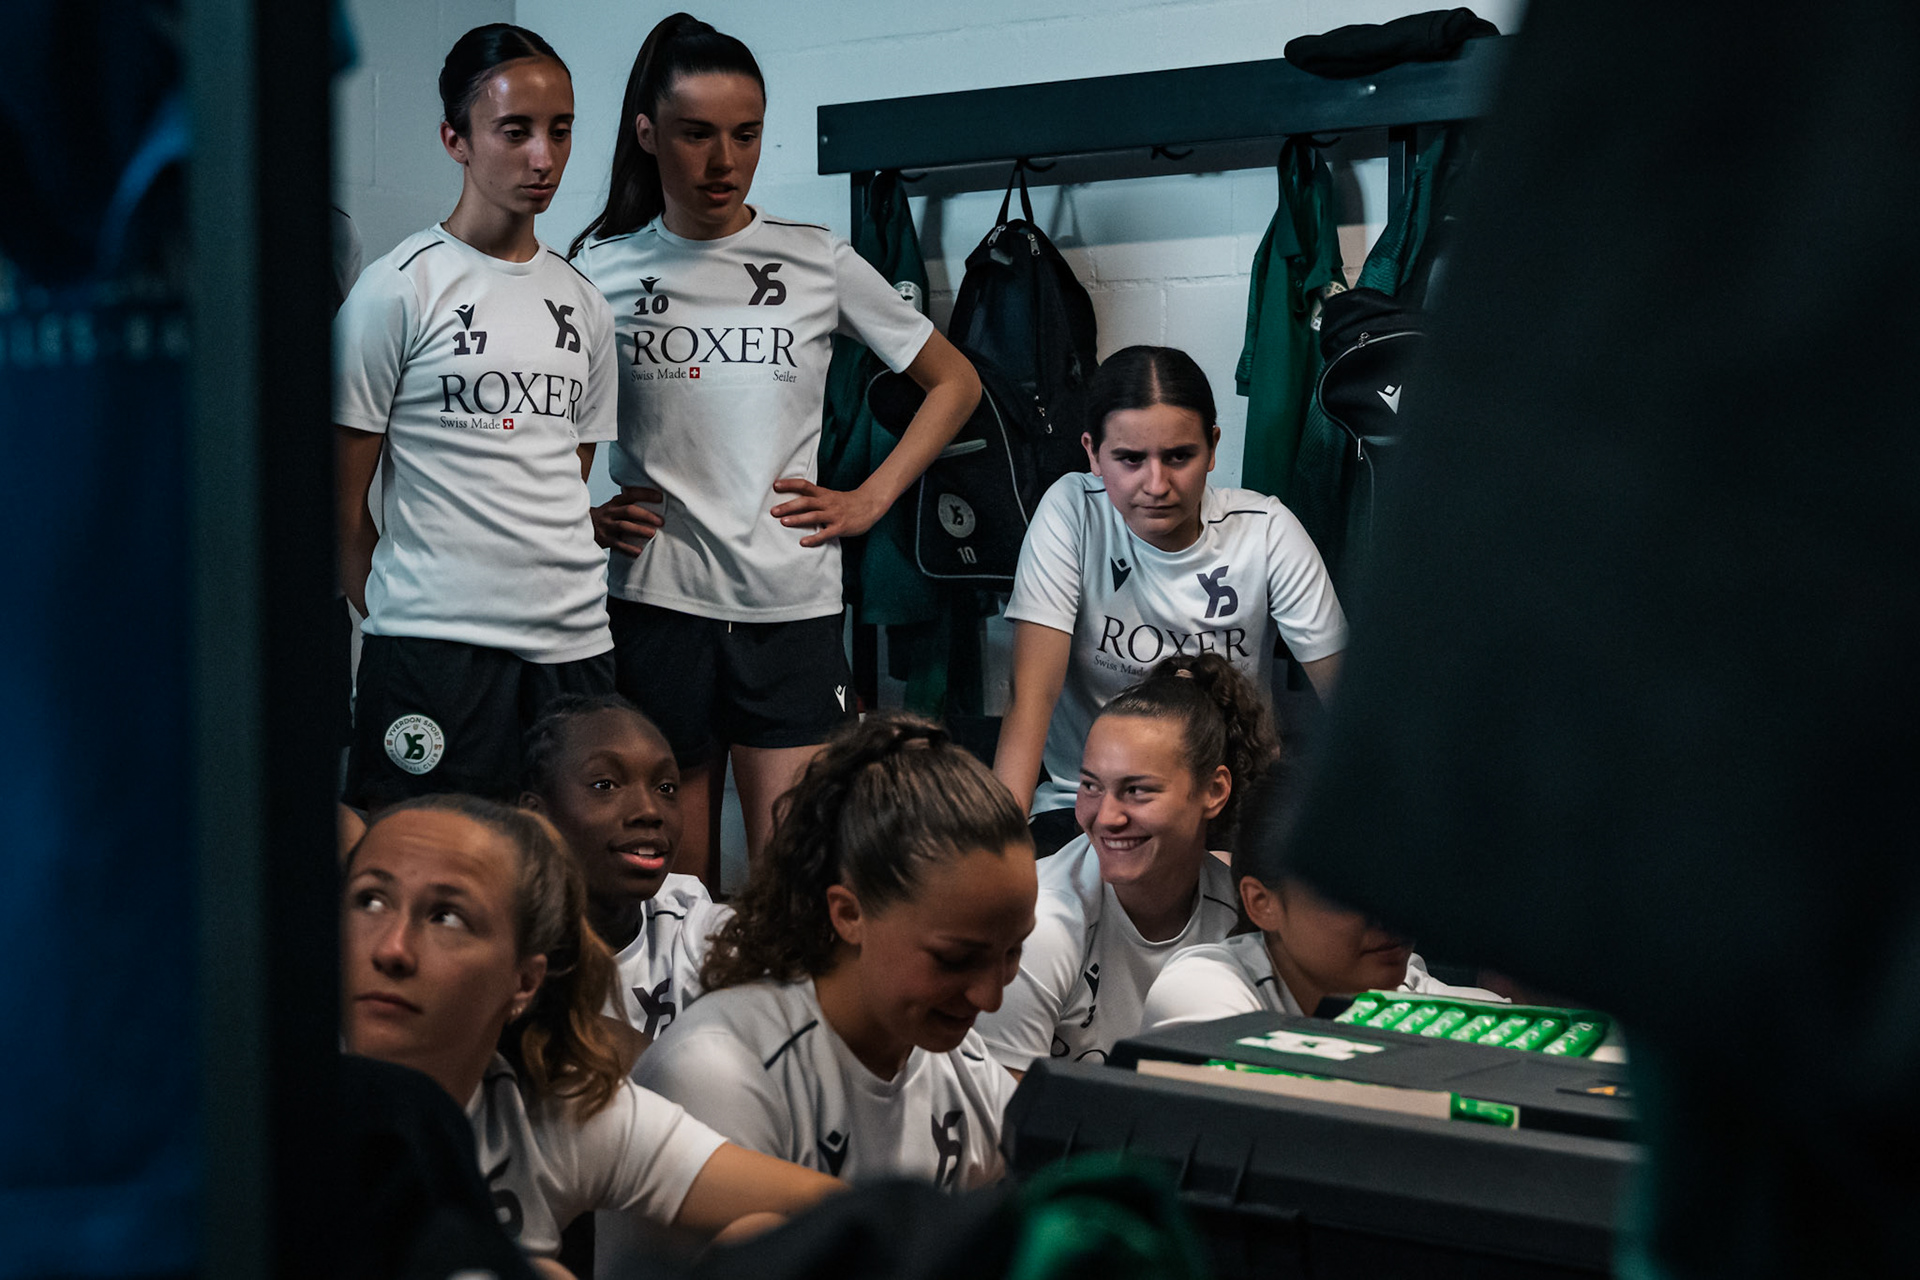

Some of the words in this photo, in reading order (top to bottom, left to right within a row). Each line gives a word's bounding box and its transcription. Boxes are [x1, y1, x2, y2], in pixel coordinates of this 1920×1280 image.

[634, 294, 669, 316] 10
[452, 330, 488, 356] 17
[630, 325, 799, 368] ROXER
[631, 370, 654, 382] Swiss
[657, 367, 687, 380] Made
[772, 369, 798, 384] Seiler
[438, 370, 584, 425] ROXER
[440, 415, 468, 429] Swiss
[471, 418, 501, 430] Made
[957, 546, 977, 564] 10
[1094, 654, 1119, 672] Swiss
[1120, 664, 1150, 677] Mad
[388, 717, 421, 736] YVERDON
[423, 720, 441, 740] SPORT
[423, 753, 438, 769] CLUB
